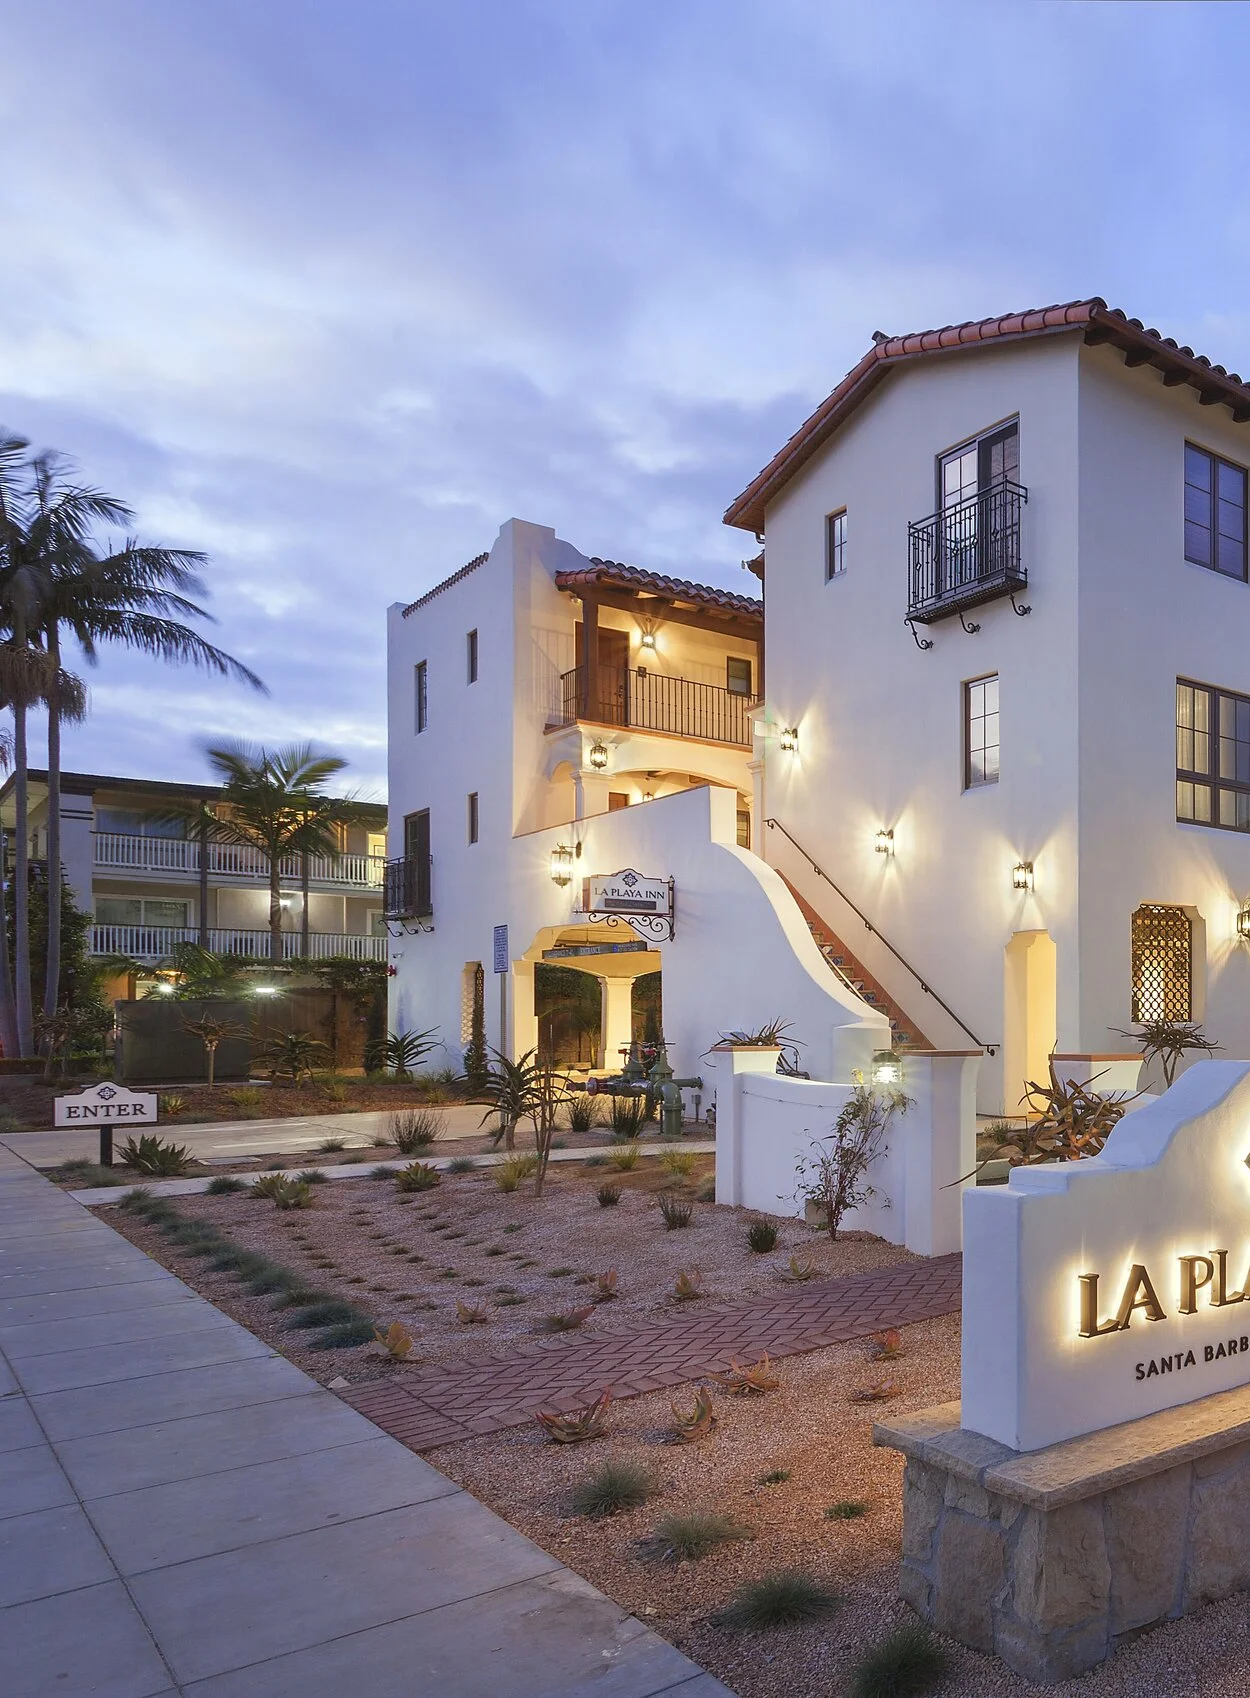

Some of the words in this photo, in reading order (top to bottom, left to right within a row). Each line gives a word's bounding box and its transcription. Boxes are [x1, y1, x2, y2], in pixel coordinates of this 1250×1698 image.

[594, 887, 609, 897] LA
[611, 888, 643, 899] PLAYA
[645, 890, 665, 900] INN
[66, 1103, 147, 1119] ENTER
[1077, 1263, 1167, 1338] LA
[1135, 1352, 1196, 1381] SANTA
